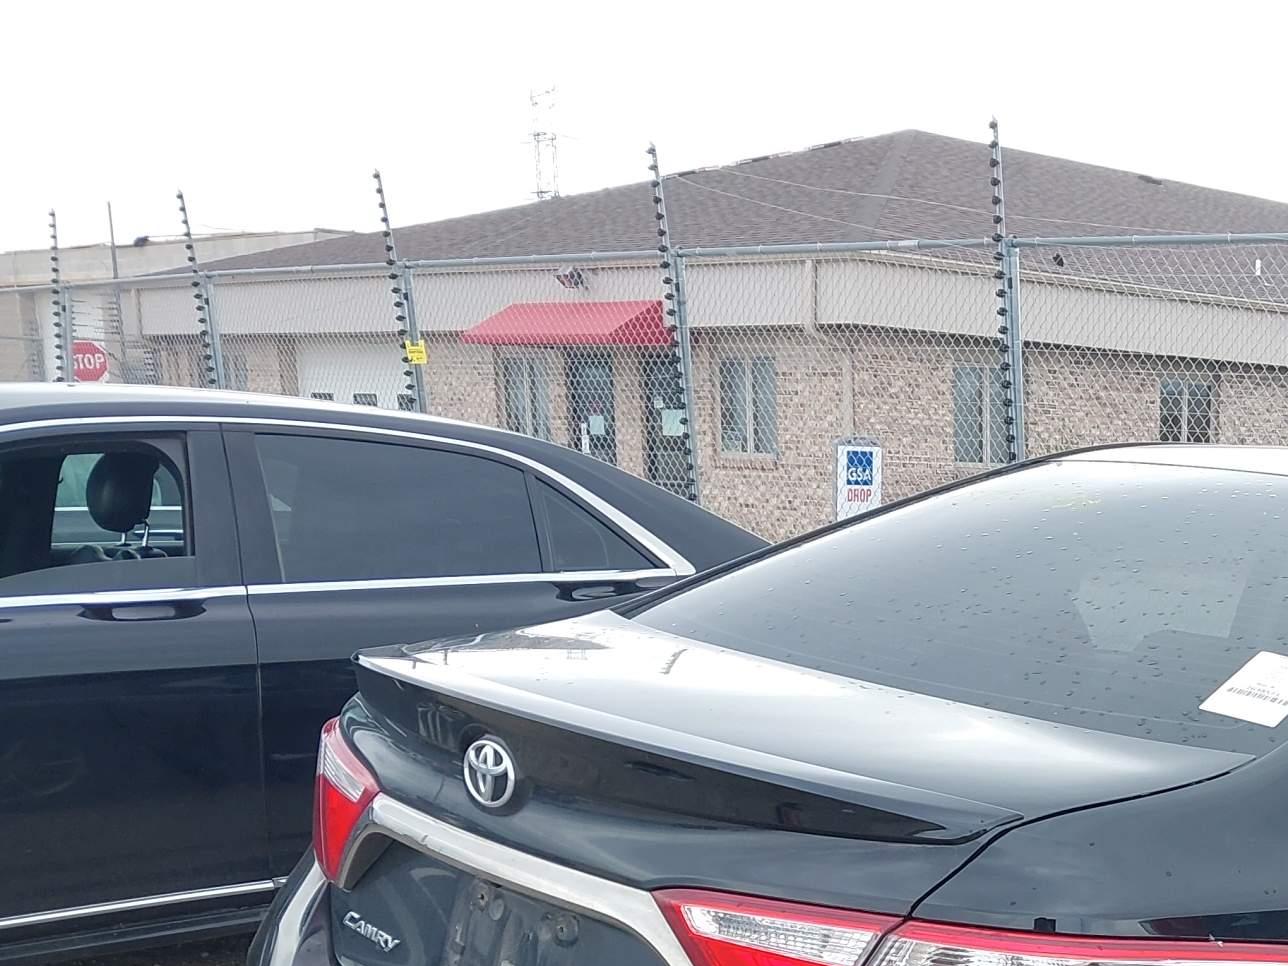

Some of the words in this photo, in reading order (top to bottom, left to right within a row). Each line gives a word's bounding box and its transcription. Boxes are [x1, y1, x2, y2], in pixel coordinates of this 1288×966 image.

[847, 467, 872, 481] GSA
[847, 488, 872, 502] DROP
[343, 911, 401, 953] CAMRY
